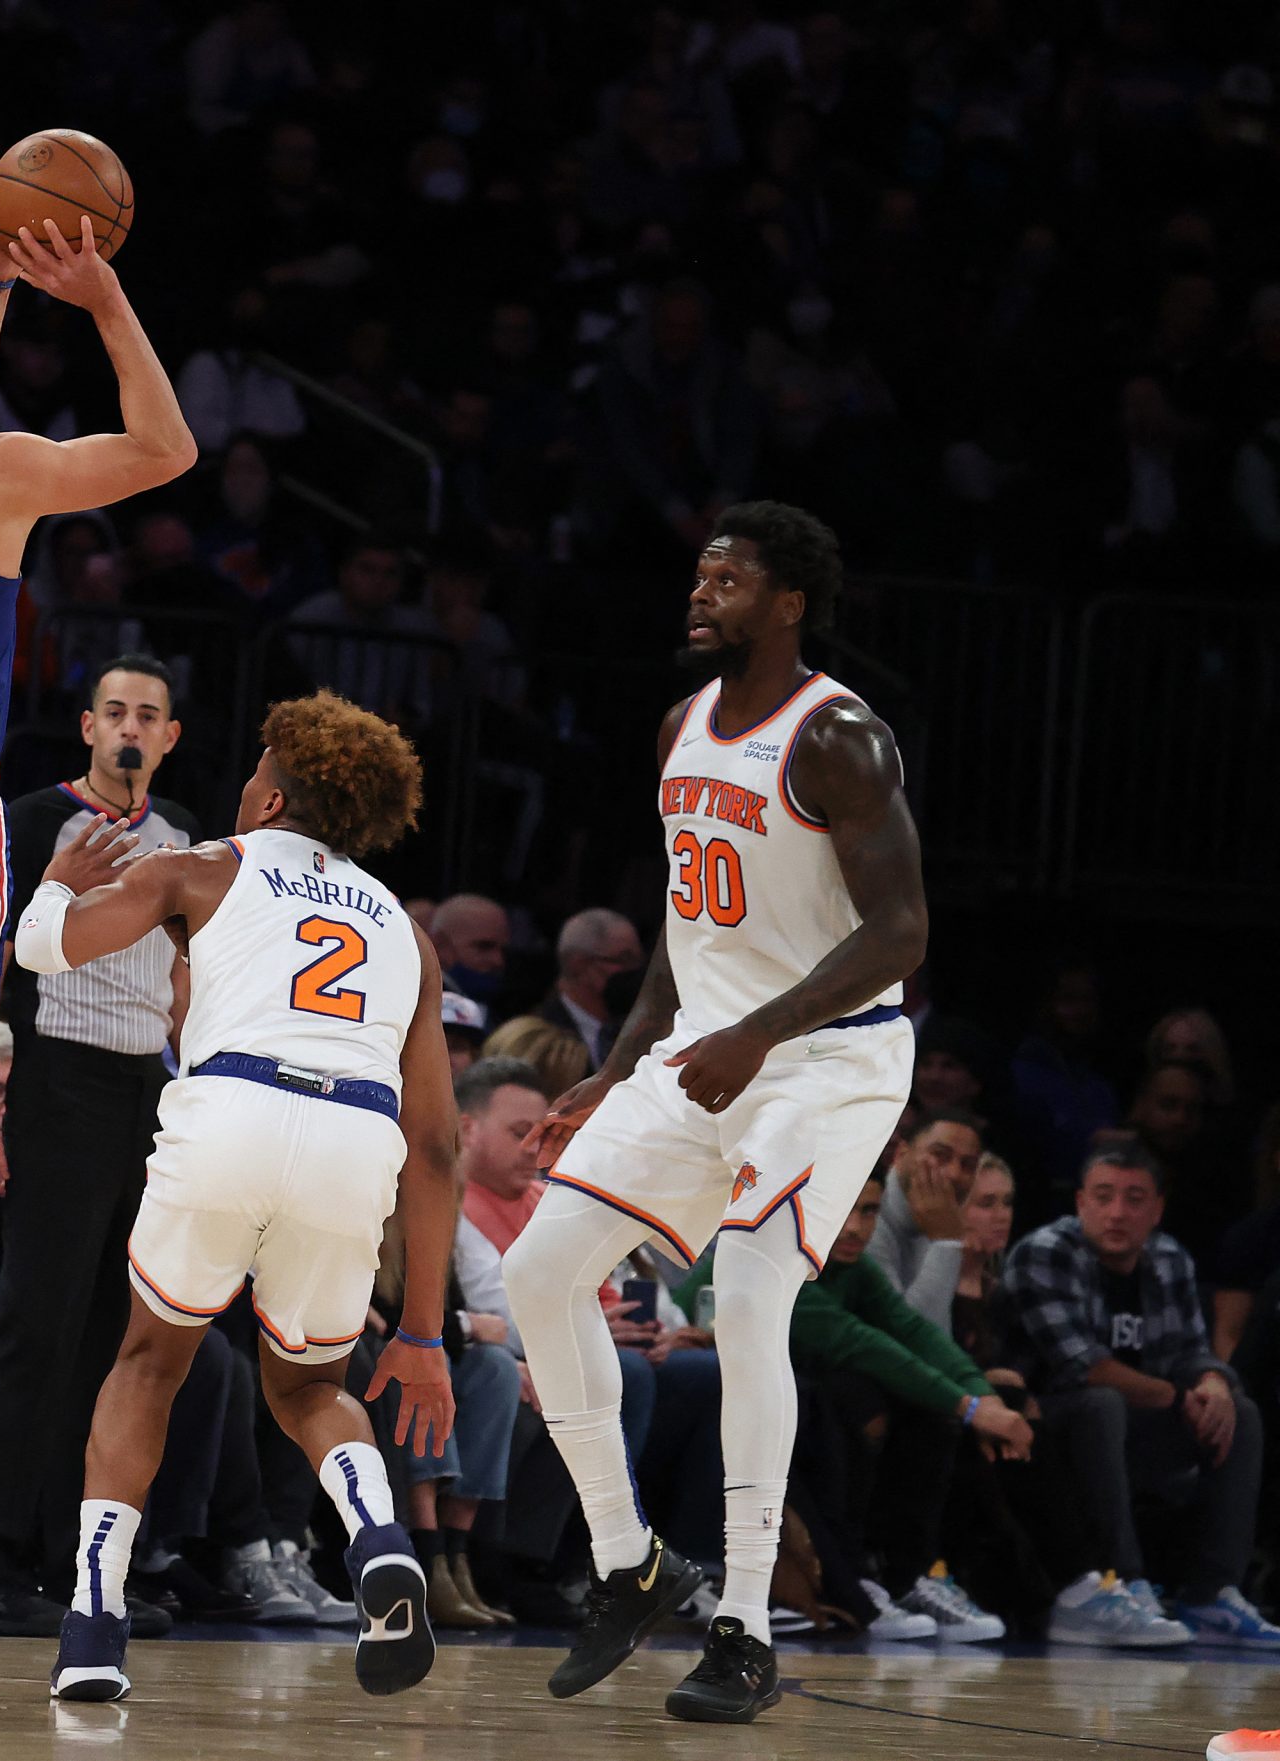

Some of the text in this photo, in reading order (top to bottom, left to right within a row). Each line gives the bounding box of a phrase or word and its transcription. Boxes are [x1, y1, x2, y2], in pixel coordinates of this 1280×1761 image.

[744, 750, 771, 761] SPACE
[747, 741, 781, 753] SQUARE
[662, 776, 768, 836] NEW YORK
[259, 868, 392, 928] McBRIDE
[671, 829, 747, 928] 30
[290, 914, 368, 1023] 2
